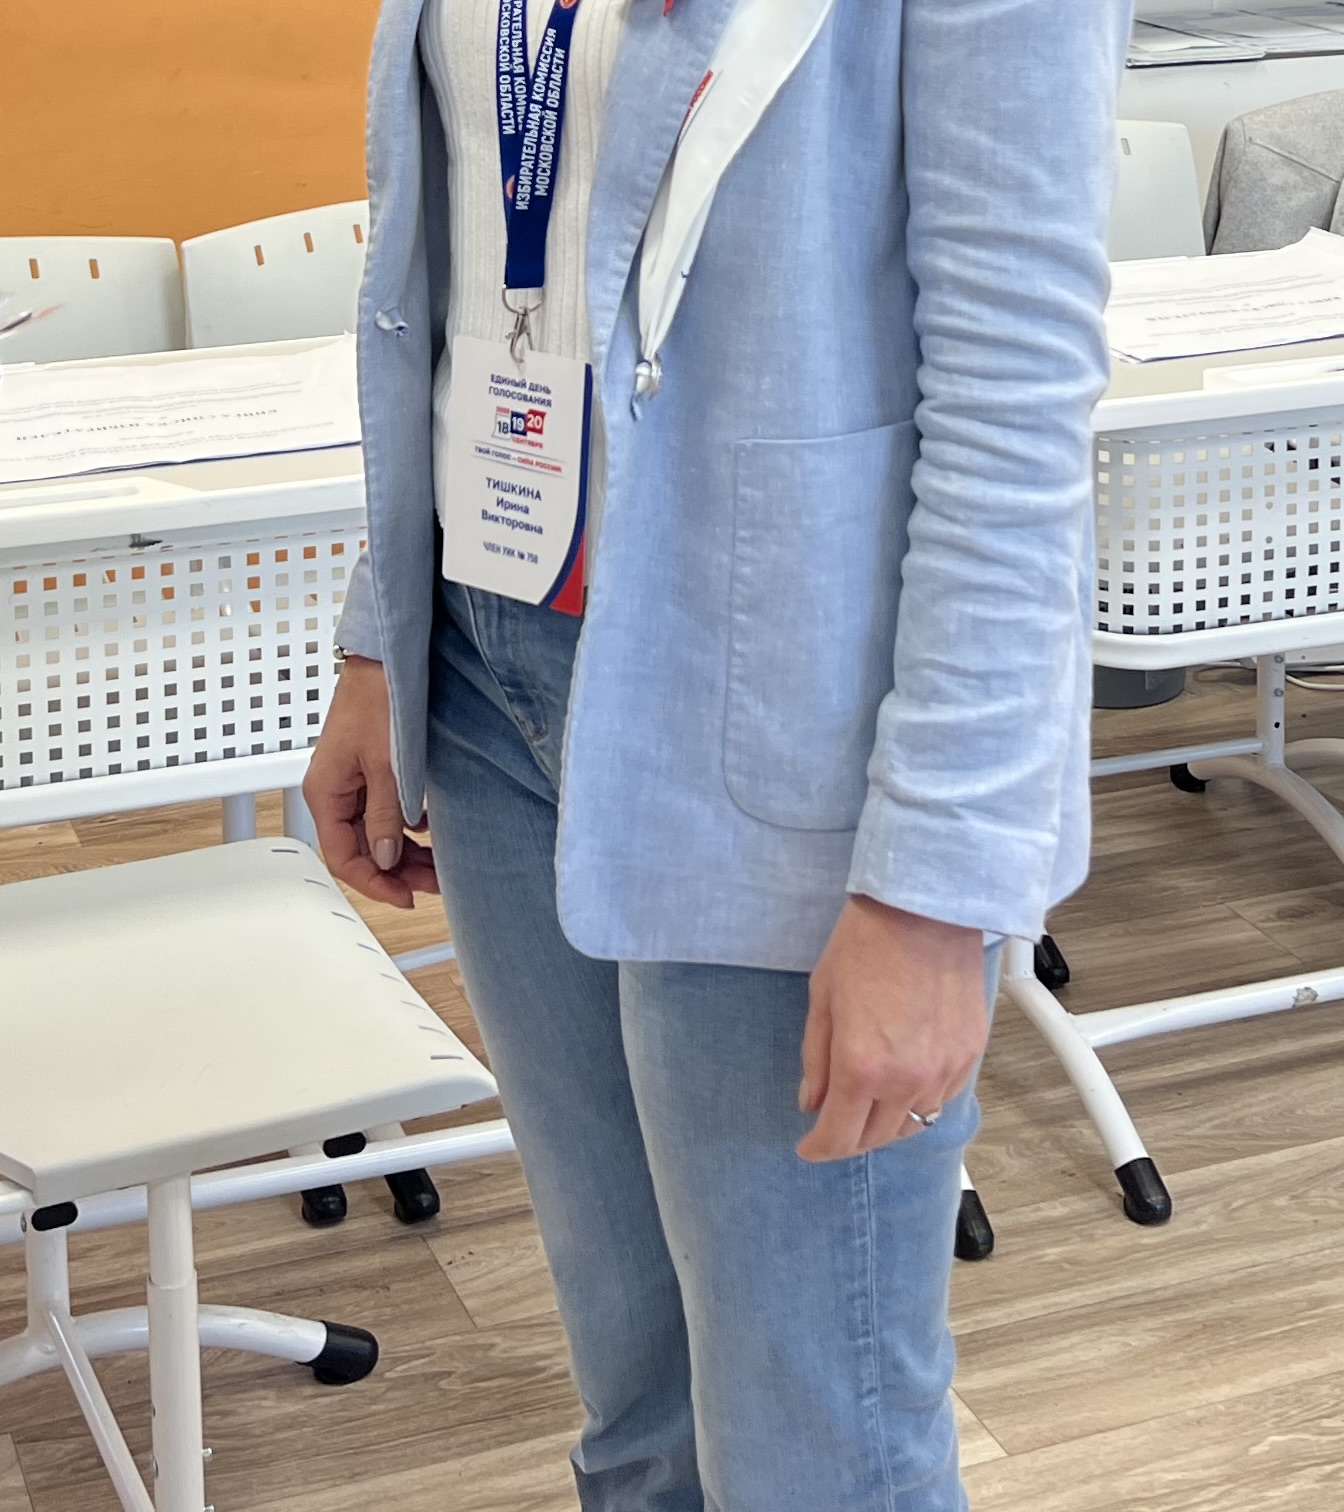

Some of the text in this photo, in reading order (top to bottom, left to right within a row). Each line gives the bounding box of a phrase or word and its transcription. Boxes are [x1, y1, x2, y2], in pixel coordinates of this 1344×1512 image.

[499, 74, 516, 135] ОБЛАСТИ
[515, 27, 557, 211] ИЗБИРАТЕЛЬНАЯ КОМИССИЯ
[535, 47, 566, 197] МОСКОВСКОЙ ОБЛАСТИ
[488, 385, 552, 408] ГОЛОСОВАНИЯ
[490, 373, 552, 395] ЕДИНЫЙ ДЕНЬ
[497, 413, 543, 434] 18 19 20
[485, 476, 542, 501] ТИШКИНА
[496, 496, 530, 515] Ирина
[481, 509, 543, 535] Викторовна
